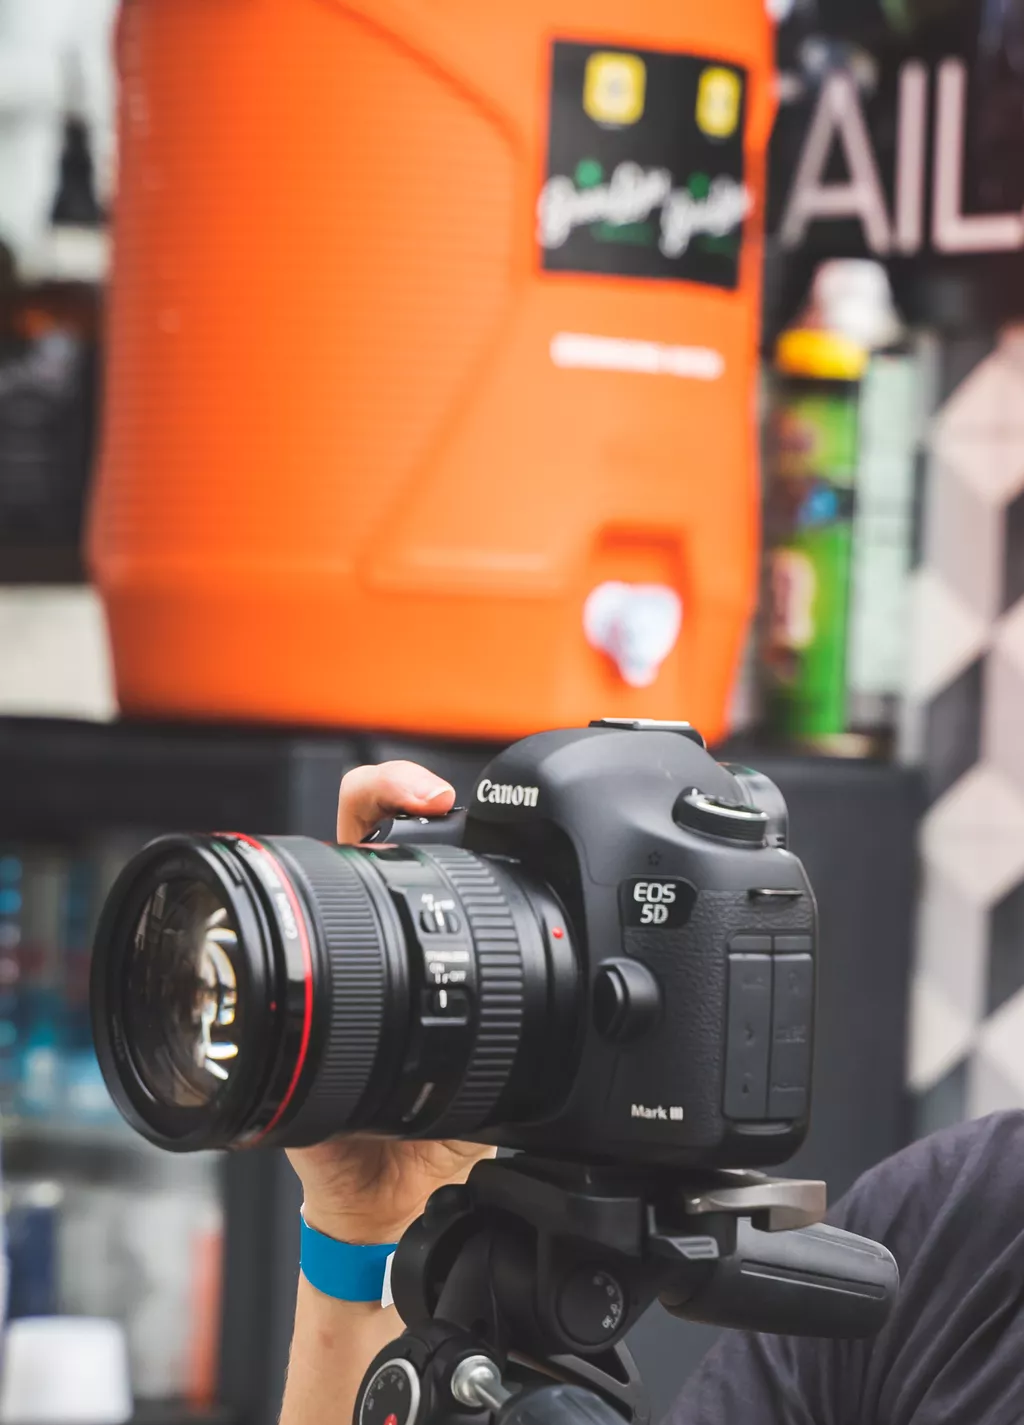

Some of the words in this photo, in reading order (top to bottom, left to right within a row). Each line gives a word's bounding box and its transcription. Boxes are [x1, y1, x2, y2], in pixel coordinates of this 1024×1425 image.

[477, 779, 539, 807] Canon
[633, 882, 676, 903] EOS
[640, 903, 669, 924] 5D
[631, 1103, 668, 1119] Mark
